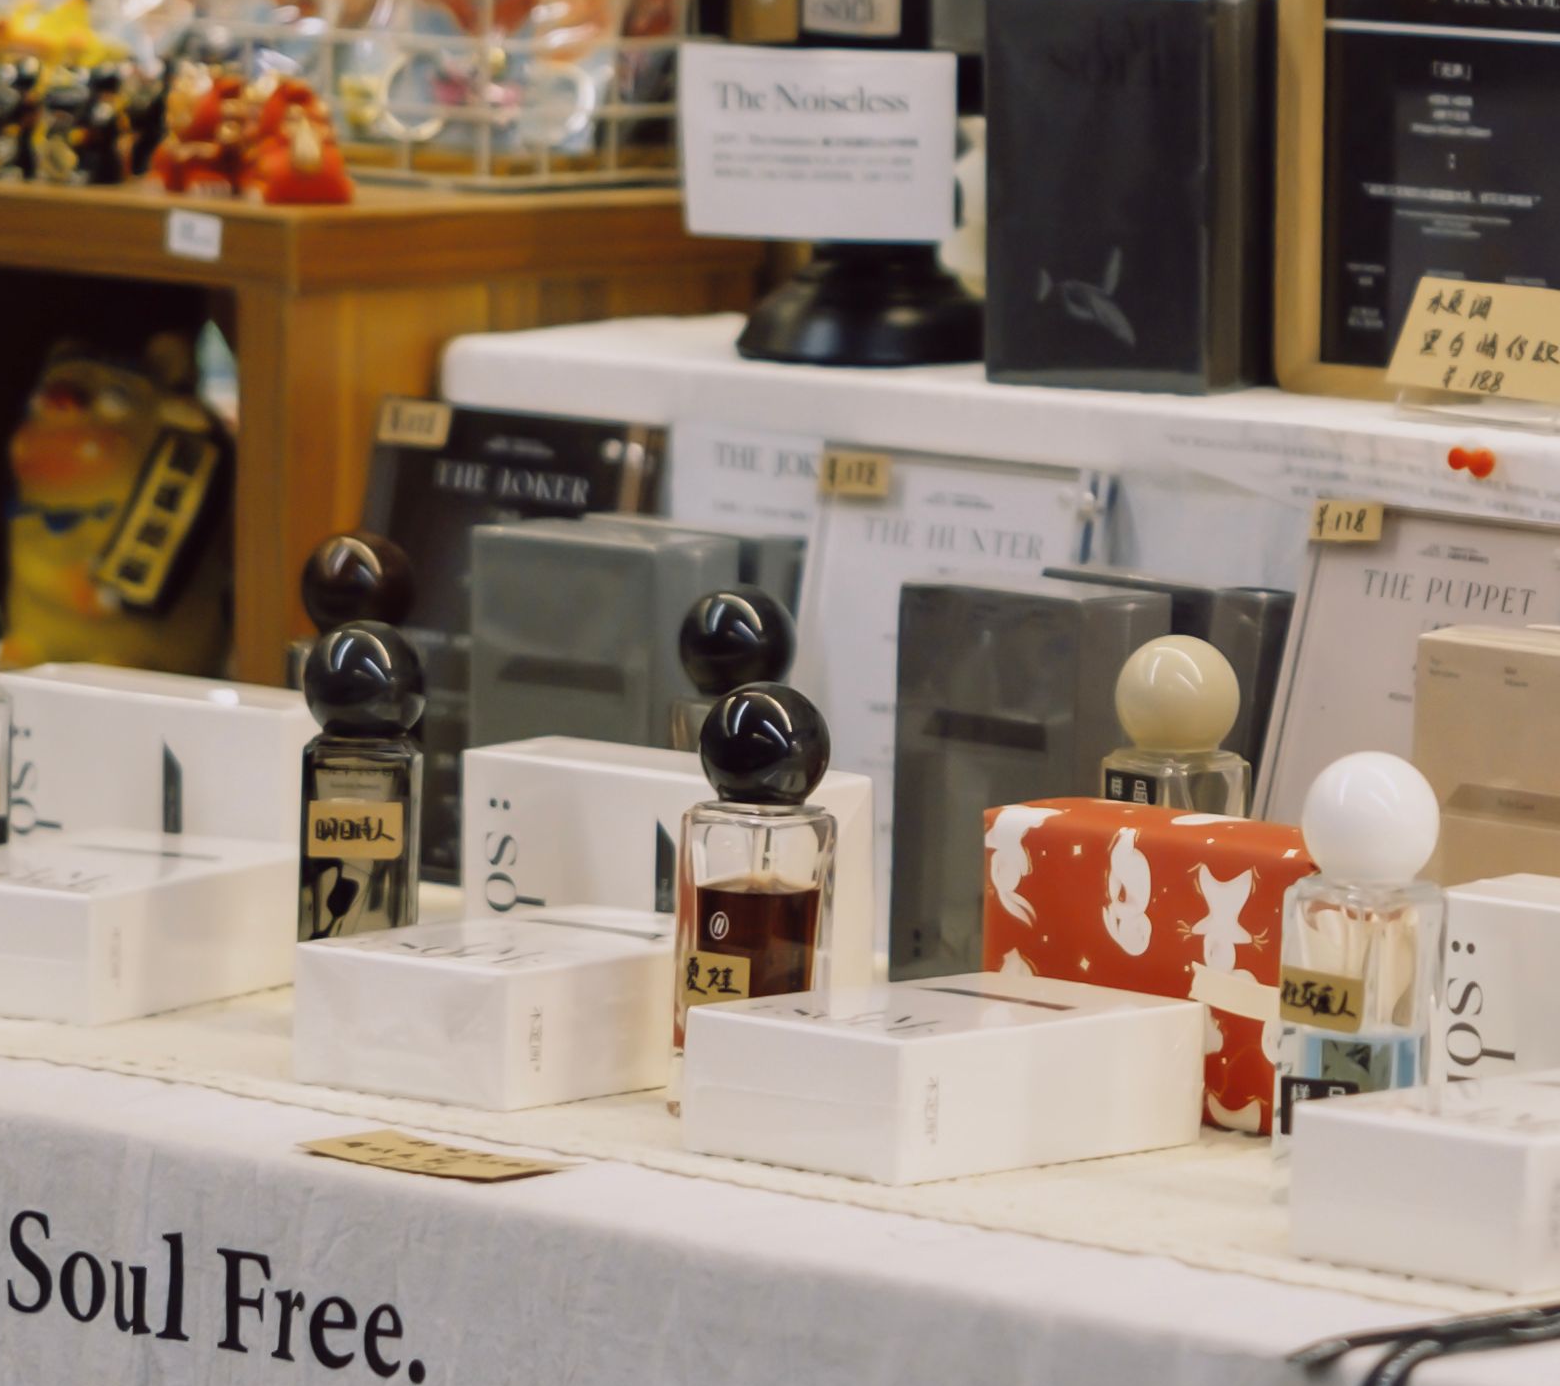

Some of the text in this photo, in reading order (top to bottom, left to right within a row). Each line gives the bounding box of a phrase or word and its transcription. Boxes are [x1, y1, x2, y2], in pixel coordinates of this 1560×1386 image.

[713, 80, 910, 114] The Noiseless
[499, 467, 590, 505] JOKER
[774, 451, 819, 480] JOK
[864, 516, 1042, 561] THE HUNTER
[1364, 568, 1537, 616] THE PUPPET
[4, 1208, 192, 1344] Soul
[214, 1246, 428, 1385] Free.
